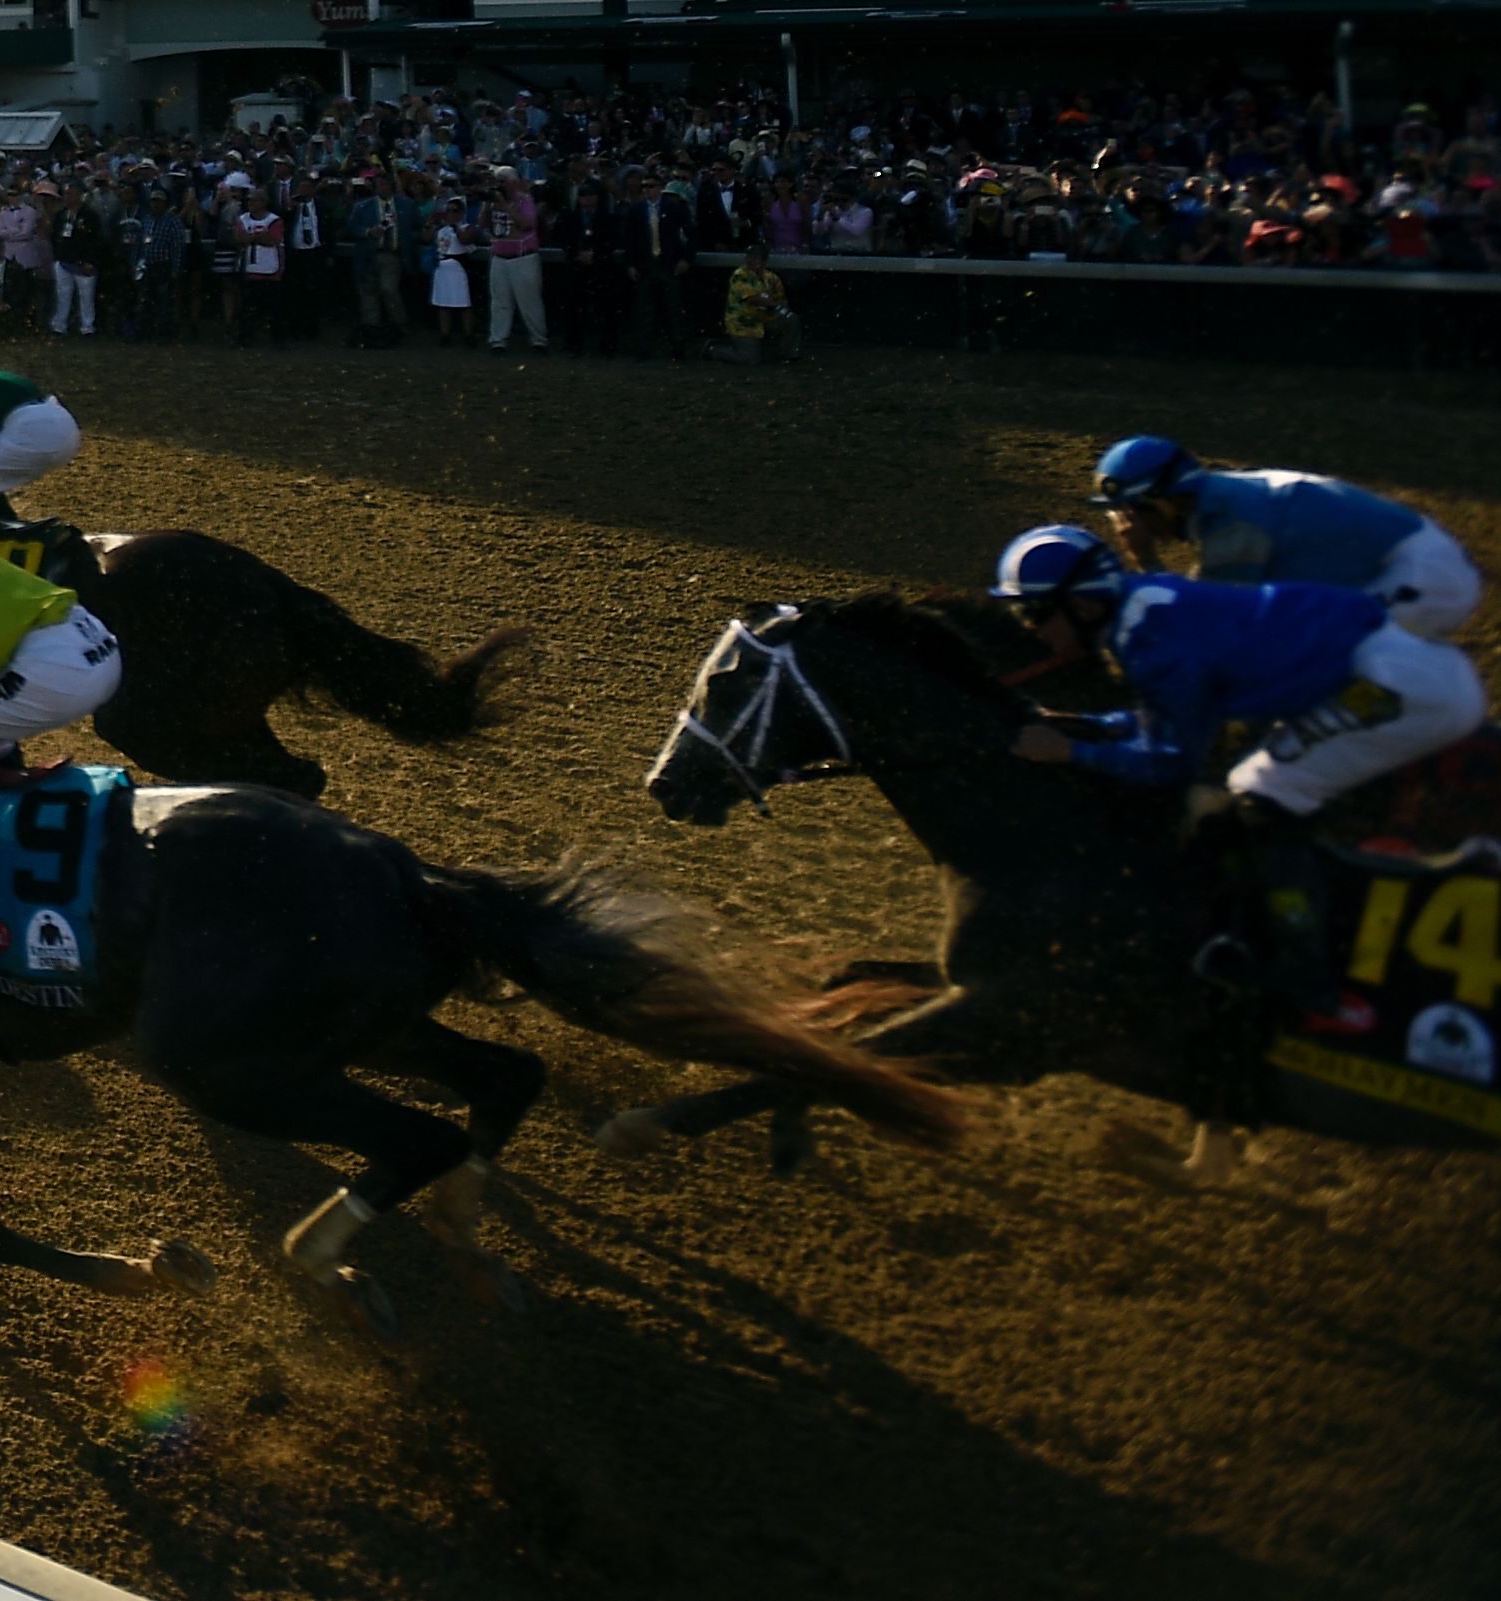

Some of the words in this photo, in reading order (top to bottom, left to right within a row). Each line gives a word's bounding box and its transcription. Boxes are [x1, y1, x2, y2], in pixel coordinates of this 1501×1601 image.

[316, 0, 368, 21] Yum
[14, 789, 91, 906] 9
[1347, 876, 1501, 1010] 14
